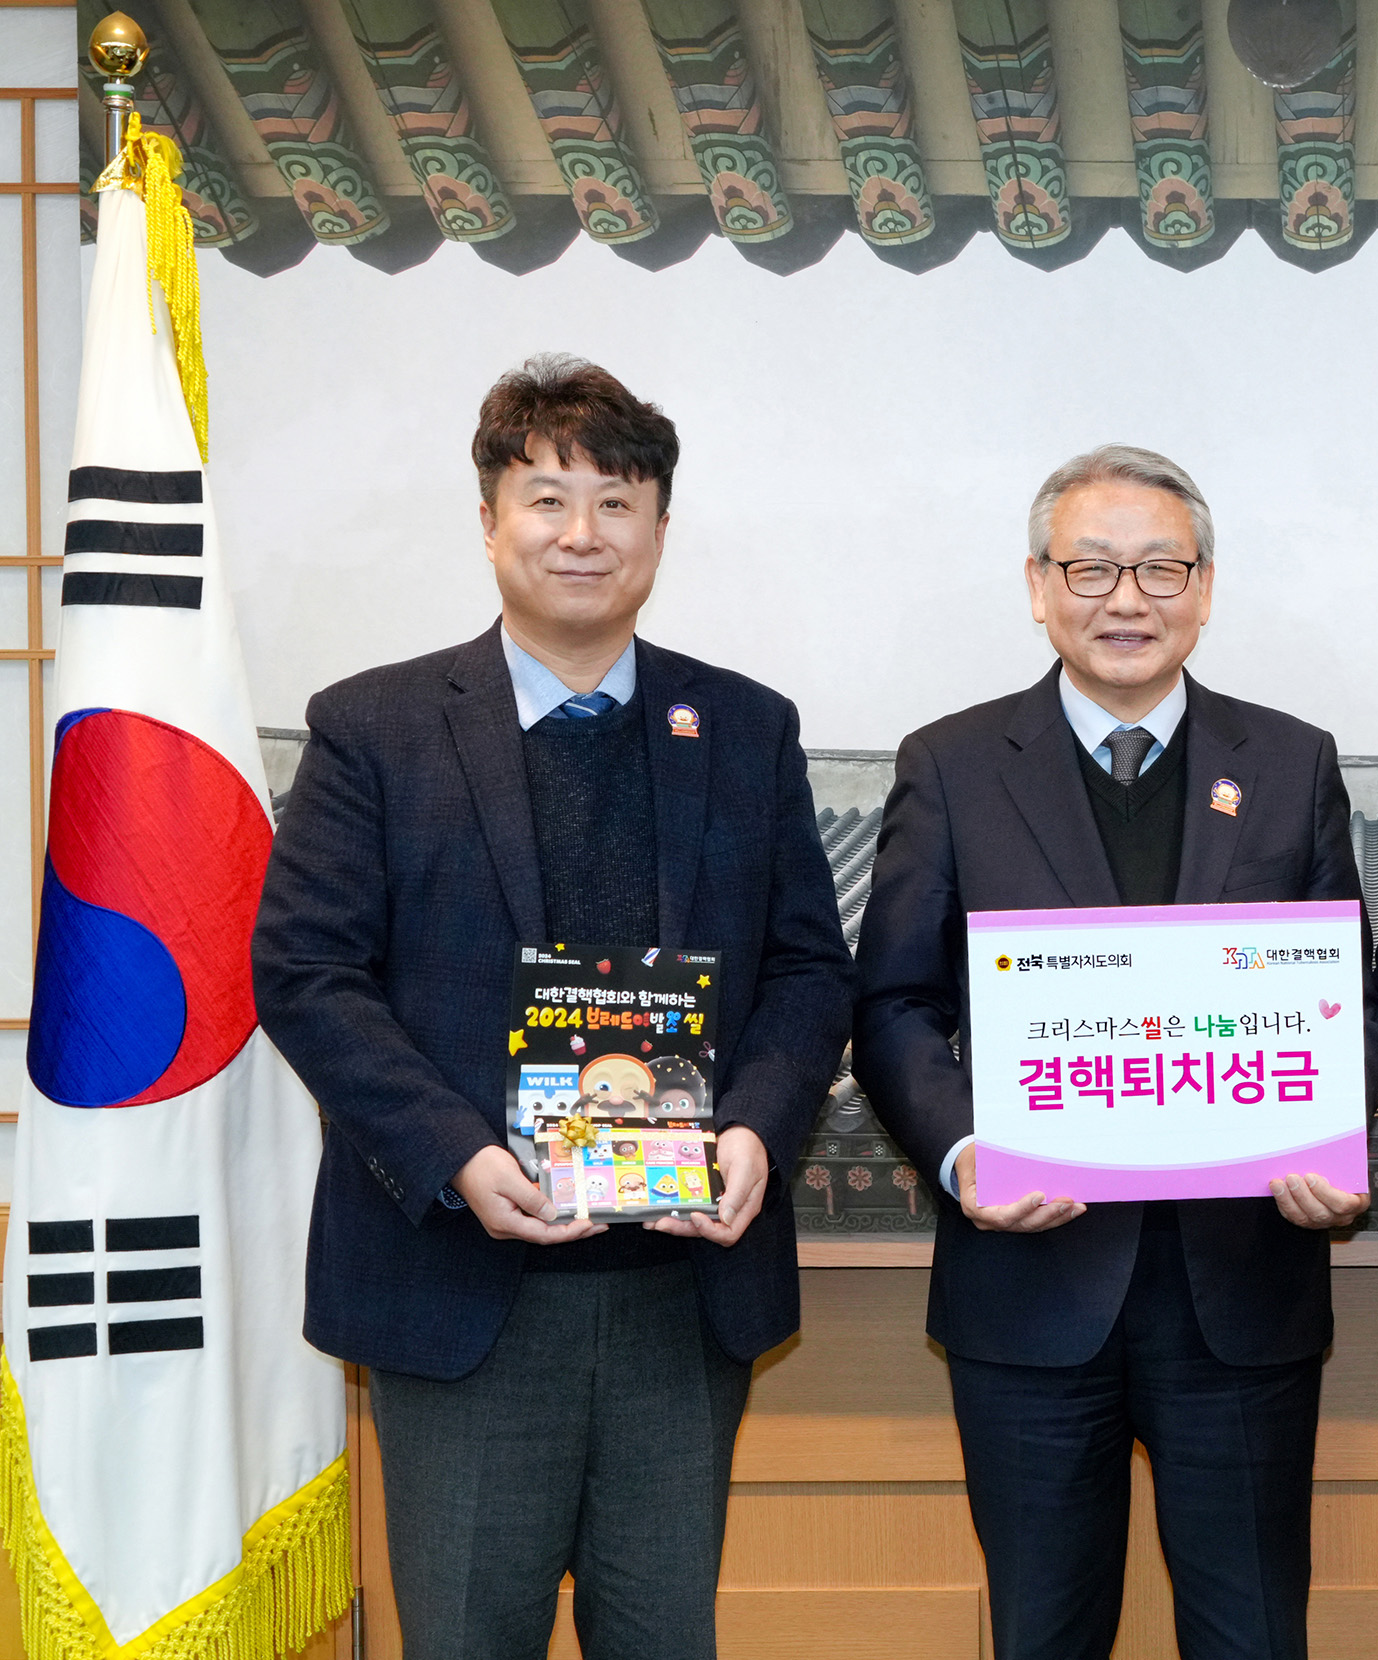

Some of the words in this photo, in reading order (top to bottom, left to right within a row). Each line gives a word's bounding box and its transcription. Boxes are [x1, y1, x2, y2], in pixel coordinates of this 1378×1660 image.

[1016, 953, 1045, 972] 전북
[1046, 953, 1133, 970] 특별자치도의회
[1266, 947, 1340, 961] 대한결핵협회
[534, 986, 636, 1005] 대한결핵협회와
[638, 990, 697, 1008] 함께하는
[525, 1006, 583, 1028] 2024
[683, 1012, 704, 1035] 씰
[1027, 1015, 1186, 1042] 크리스마스씰은
[1194, 1011, 1312, 1038] 나눔입니다.
[526, 1076, 573, 1087] WILK
[1018, 1049, 1320, 1111] 결핵퇴치성금
